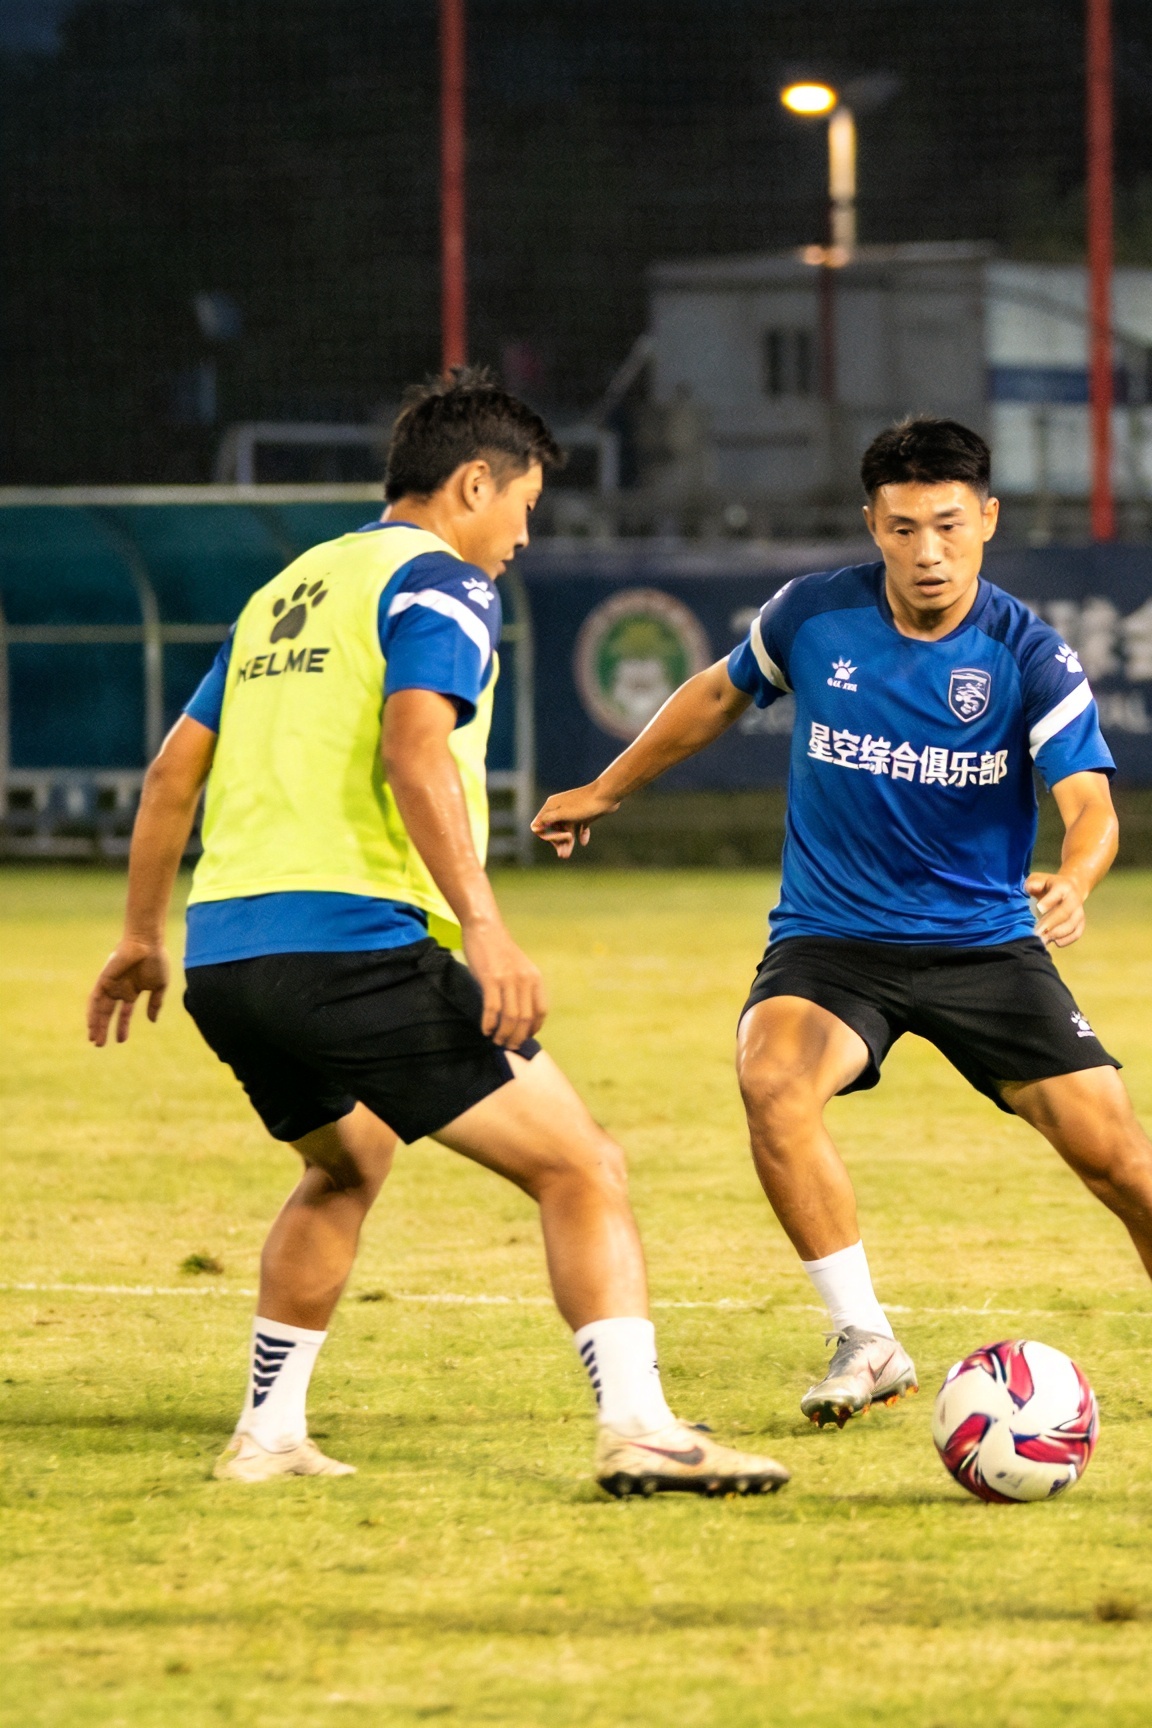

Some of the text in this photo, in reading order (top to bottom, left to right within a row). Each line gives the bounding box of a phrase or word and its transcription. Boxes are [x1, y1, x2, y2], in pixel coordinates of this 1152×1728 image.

[807, 721, 1008, 788] 星空综合俱乐部
